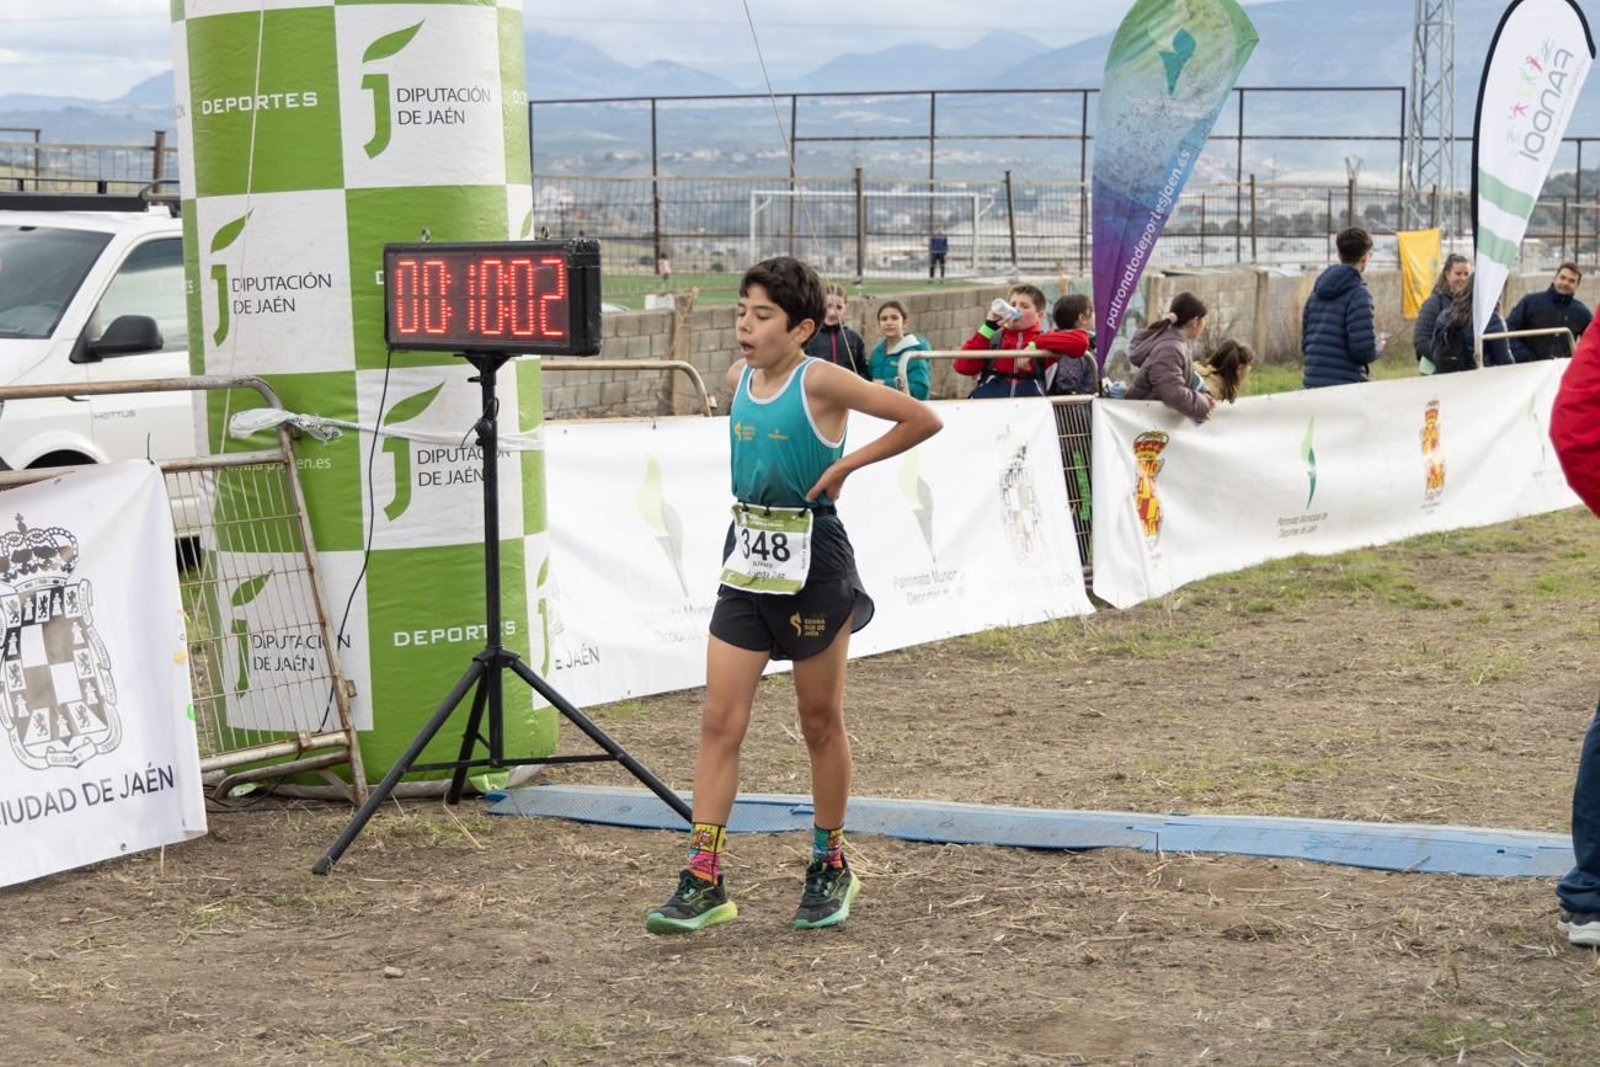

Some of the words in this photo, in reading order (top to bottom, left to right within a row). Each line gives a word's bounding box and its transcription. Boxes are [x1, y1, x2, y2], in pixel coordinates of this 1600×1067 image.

[202, 91, 318, 115] DEPORTES
[396, 86, 491, 103] DIPUTACIÓN
[398, 110, 421, 125] DE
[425, 107, 465, 125] JAÉN
[1106, 149, 1191, 329] patronatodeportesjaen.es
[232, 272, 332, 293] DIPUTACIÓN
[233, 300, 252, 314] DE
[255, 296, 295, 314] JAÉN
[418, 471, 442, 487] DE
[741, 528, 790, 562] 348
[394, 620, 516, 646] DEPORTS
[253, 655, 272, 671] DE
[275, 654, 315, 672] JAÉN
[566, 643, 600, 668] JAÉN
[0, 787, 77, 827] IUDAD
[82, 777, 114, 807] DE
[120, 762, 174, 799] JAÉN
